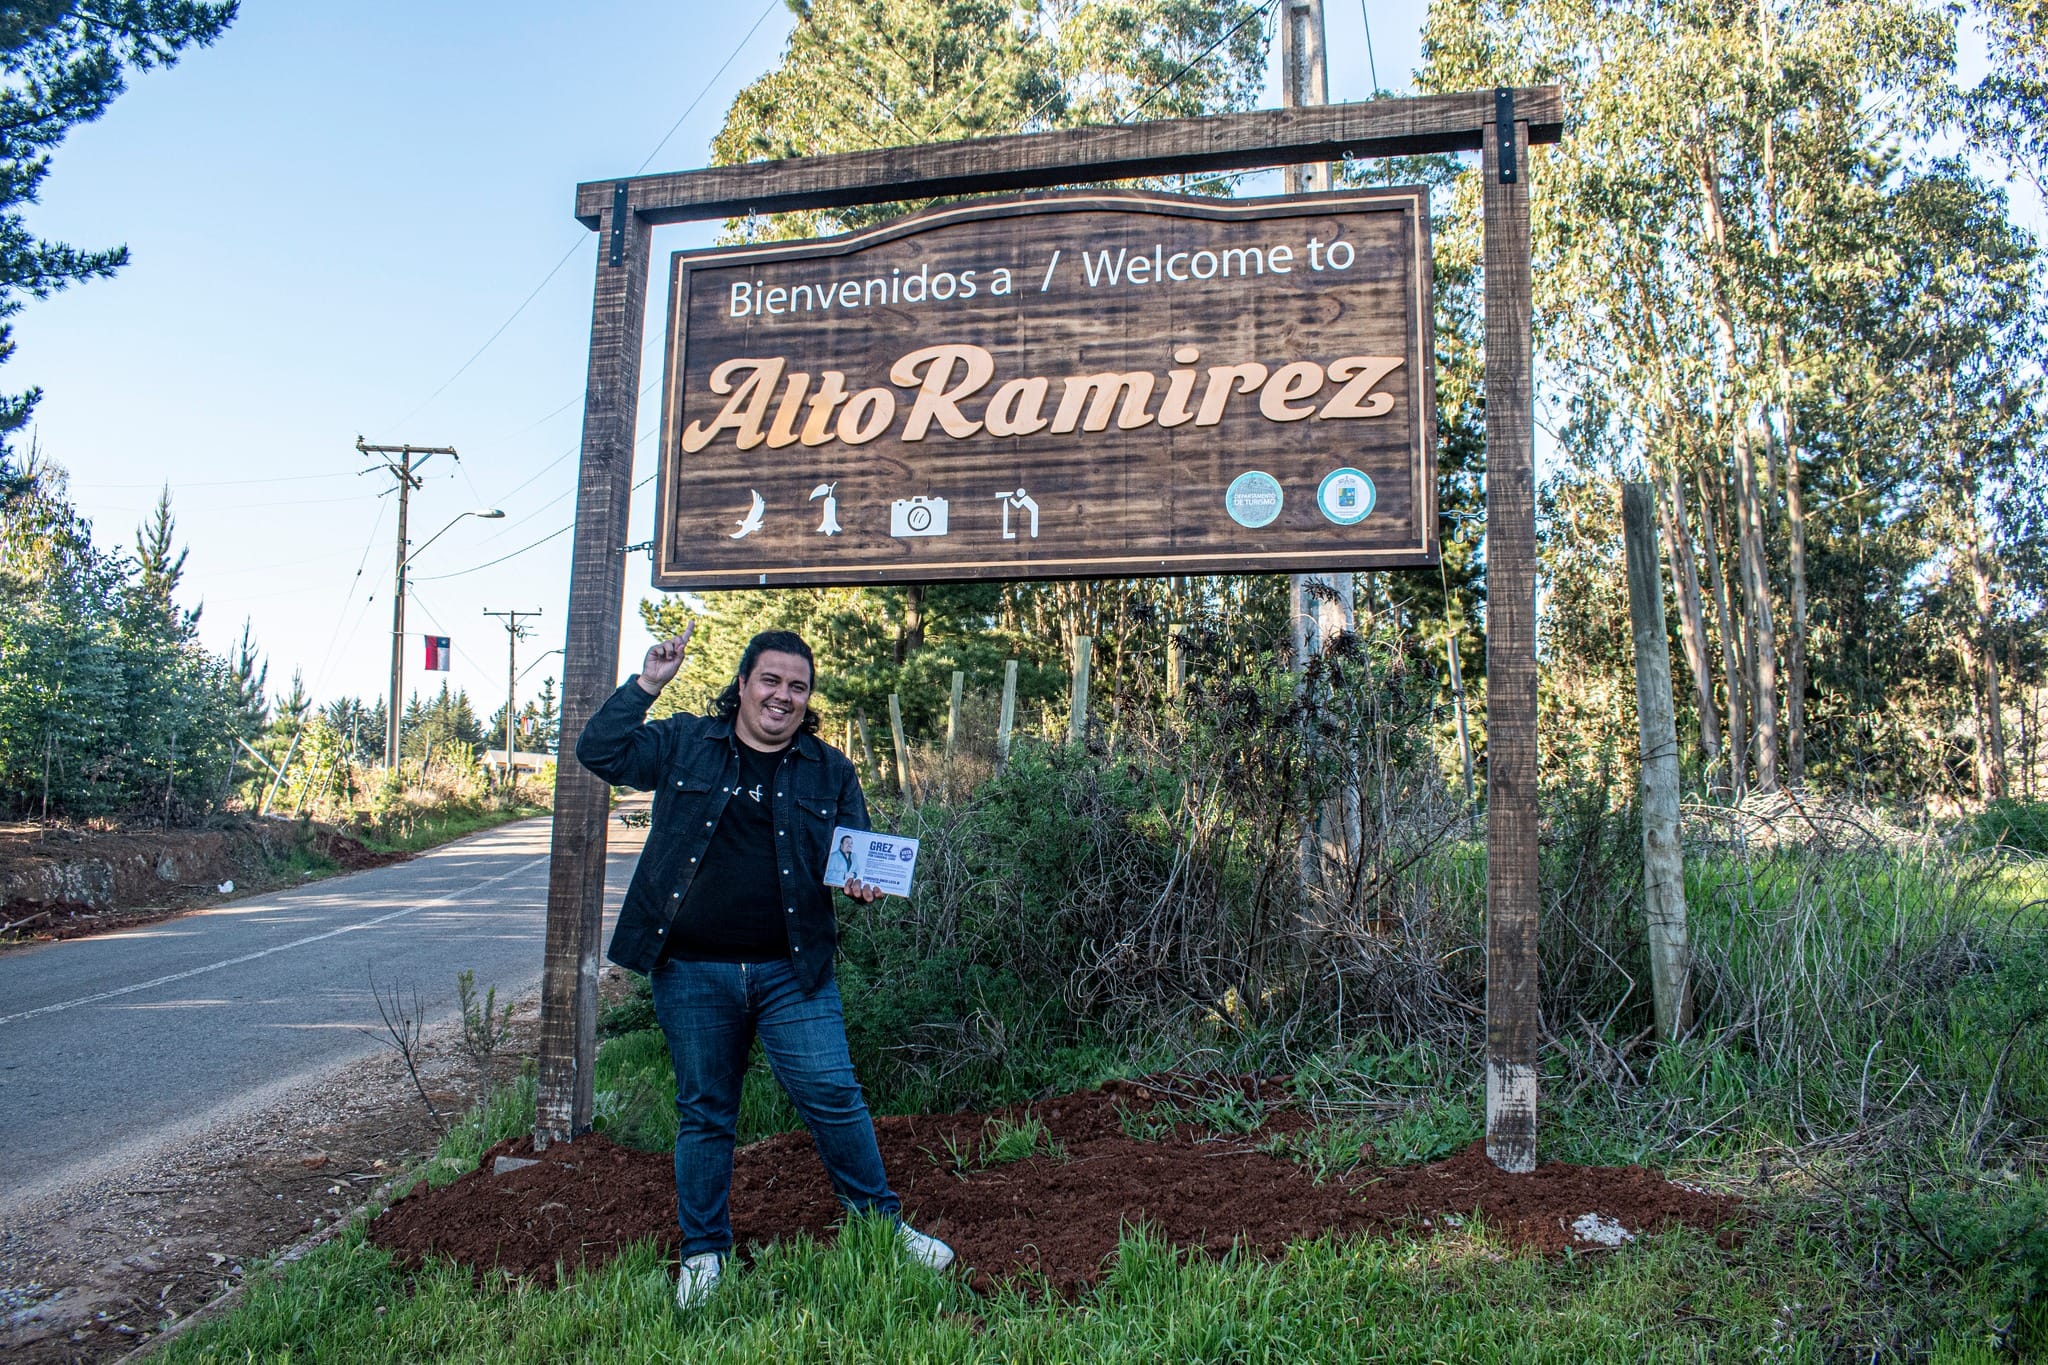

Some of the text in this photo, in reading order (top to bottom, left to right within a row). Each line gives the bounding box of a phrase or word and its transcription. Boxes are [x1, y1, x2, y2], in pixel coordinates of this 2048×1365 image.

[729, 263, 977, 318] Bienvenidos
[990, 267, 1012, 296] a
[1082, 243, 1294, 288] Welcome
[1306, 237, 1356, 271] to
[1245, 498, 1276, 506] TURISMO
[869, 841, 894, 853] GREZ
